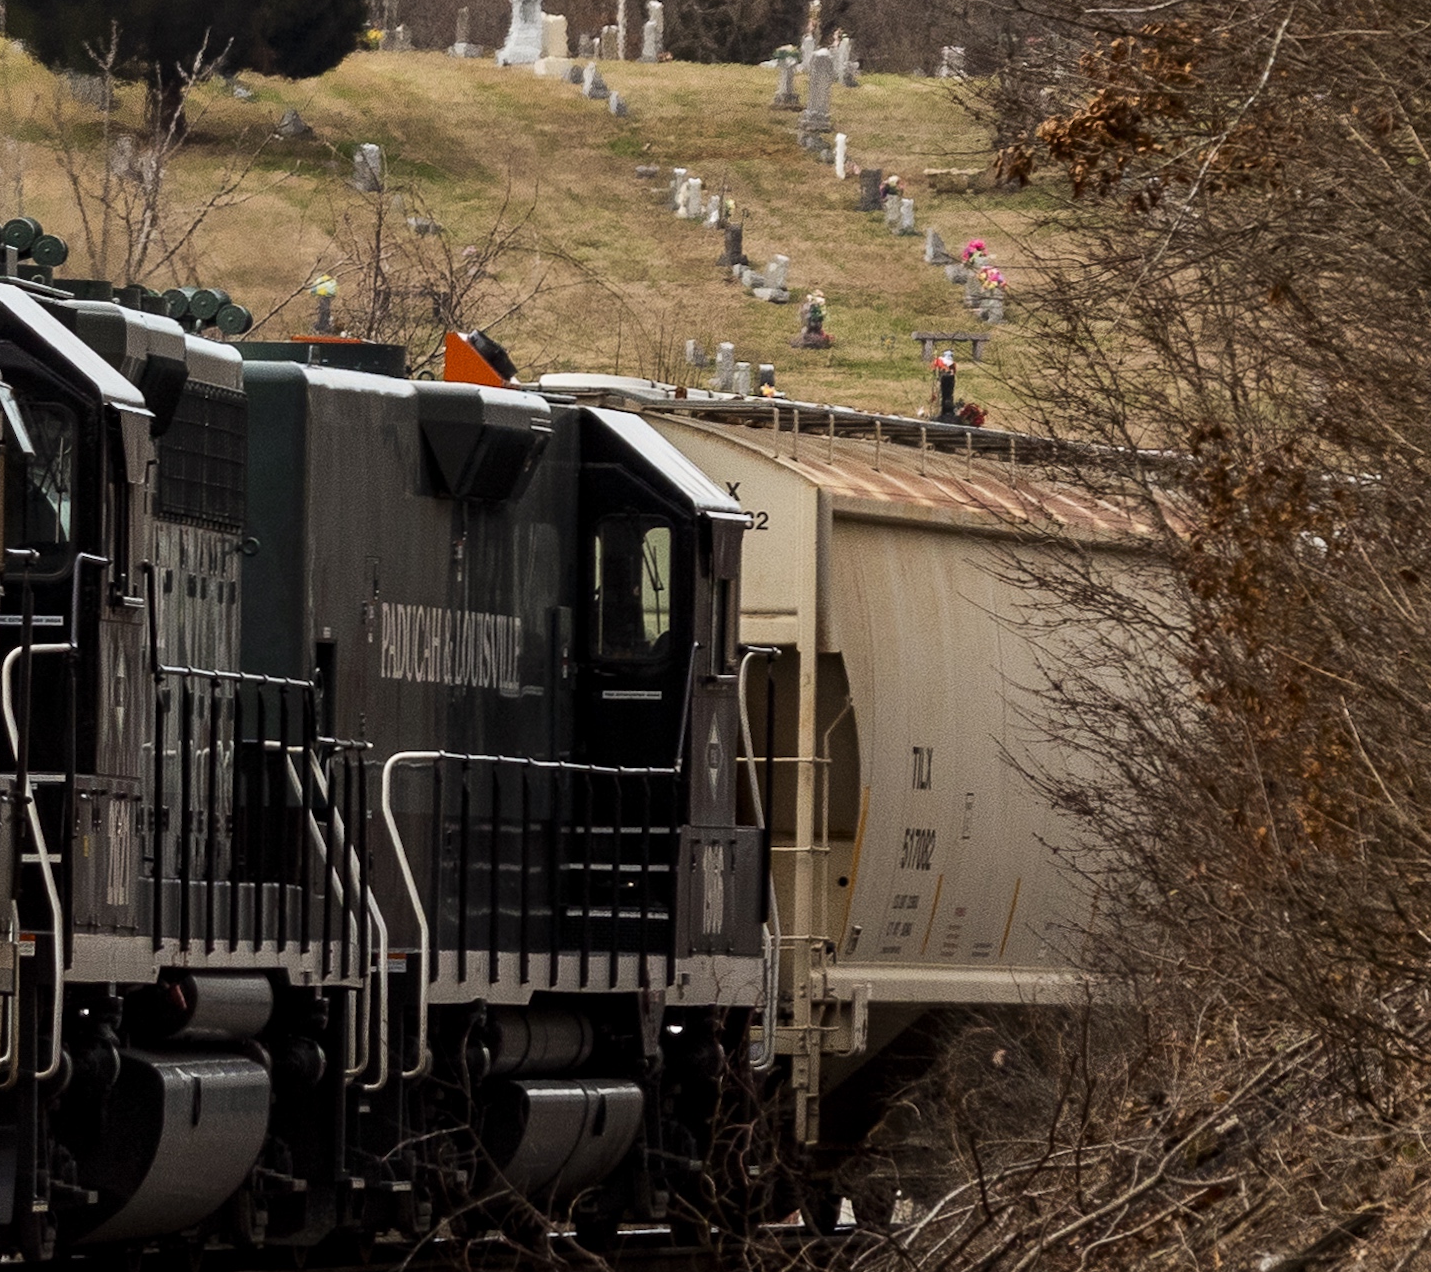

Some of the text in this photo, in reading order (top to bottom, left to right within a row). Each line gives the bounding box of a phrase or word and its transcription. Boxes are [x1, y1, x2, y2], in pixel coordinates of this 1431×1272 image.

[380, 601, 523, 690] PADUCAH & LOUISVILLE
